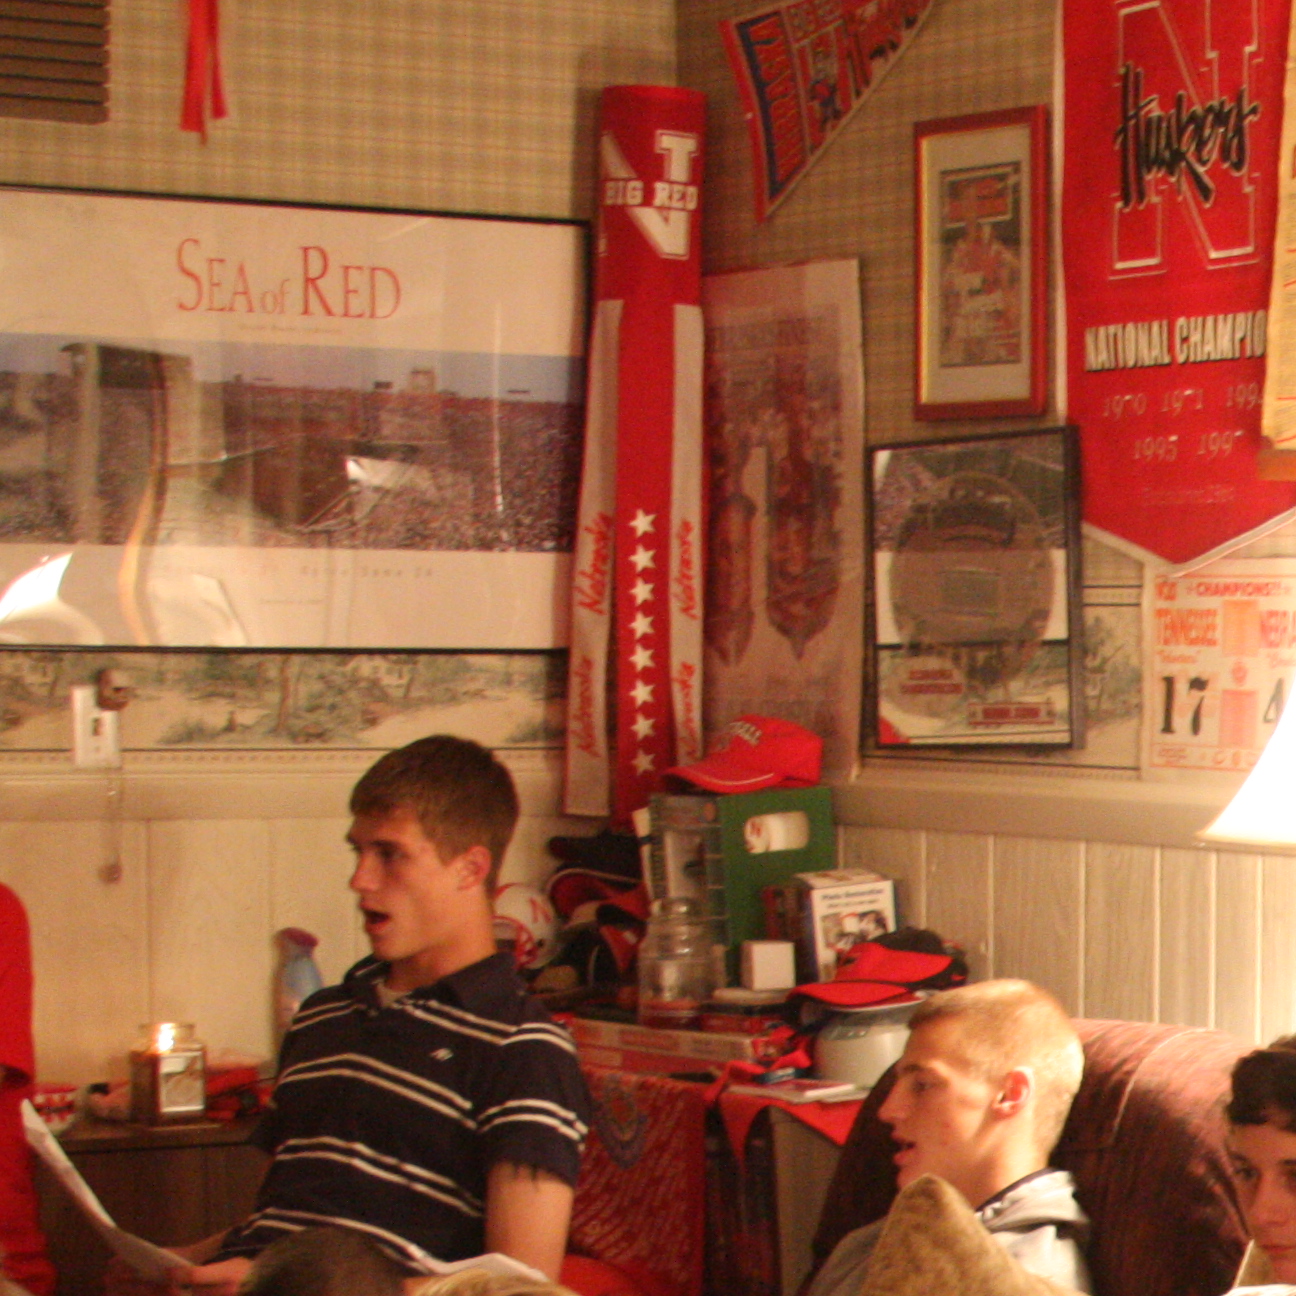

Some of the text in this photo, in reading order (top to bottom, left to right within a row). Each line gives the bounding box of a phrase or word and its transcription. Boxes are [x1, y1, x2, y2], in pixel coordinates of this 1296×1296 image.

[1113, 61, 1261, 212] Huskers
[605, 180, 699, 211] BIG RED
[176, 237, 403, 320] SEA of RED
[1085, 319, 1172, 373] NATIONAL
[1174, 309, 1267, 365] CHAMPIO
[1226, 381, 1264, 410] 199
[1160, 676, 1209, 735] 17
